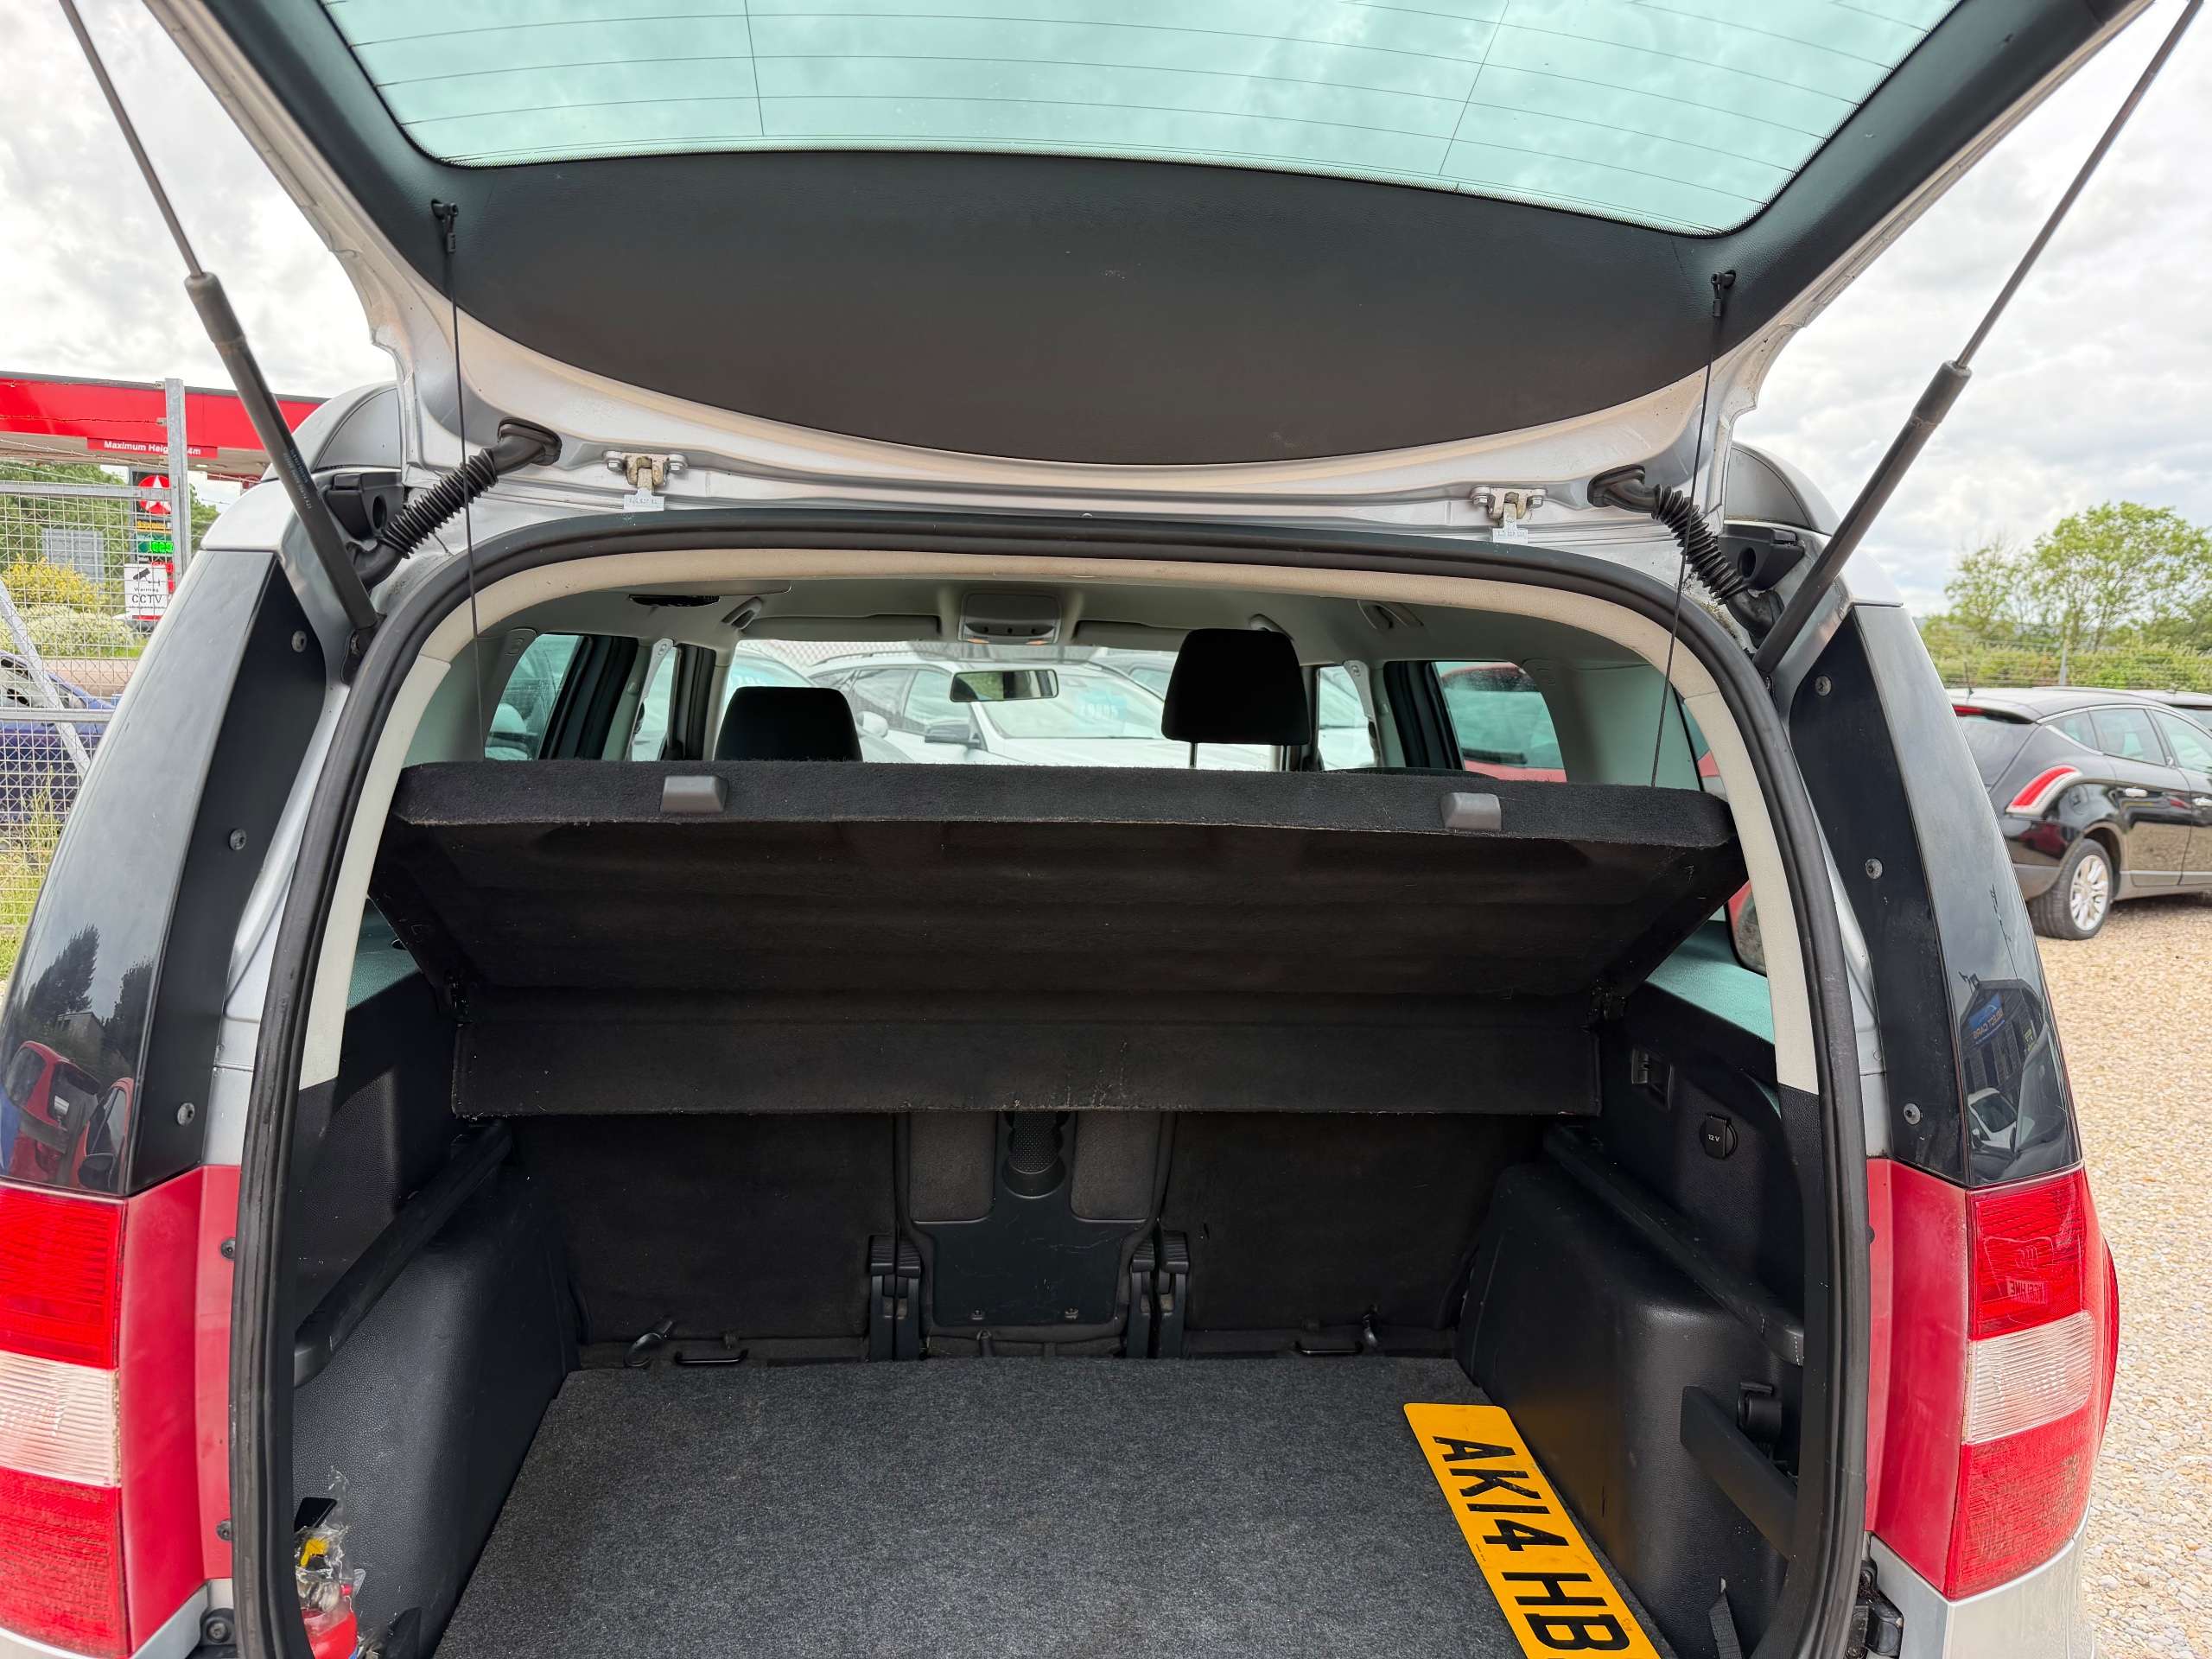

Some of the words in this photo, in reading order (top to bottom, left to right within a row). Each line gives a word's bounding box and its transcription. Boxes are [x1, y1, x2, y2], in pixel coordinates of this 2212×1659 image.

[104, 441, 147, 452] Maximum
[148, 443, 169, 454] Heig
[131, 594, 162, 604] CCTV
[1432, 1435, 1570, 1552] AK14
[1501, 1571, 1631, 1659] HB
